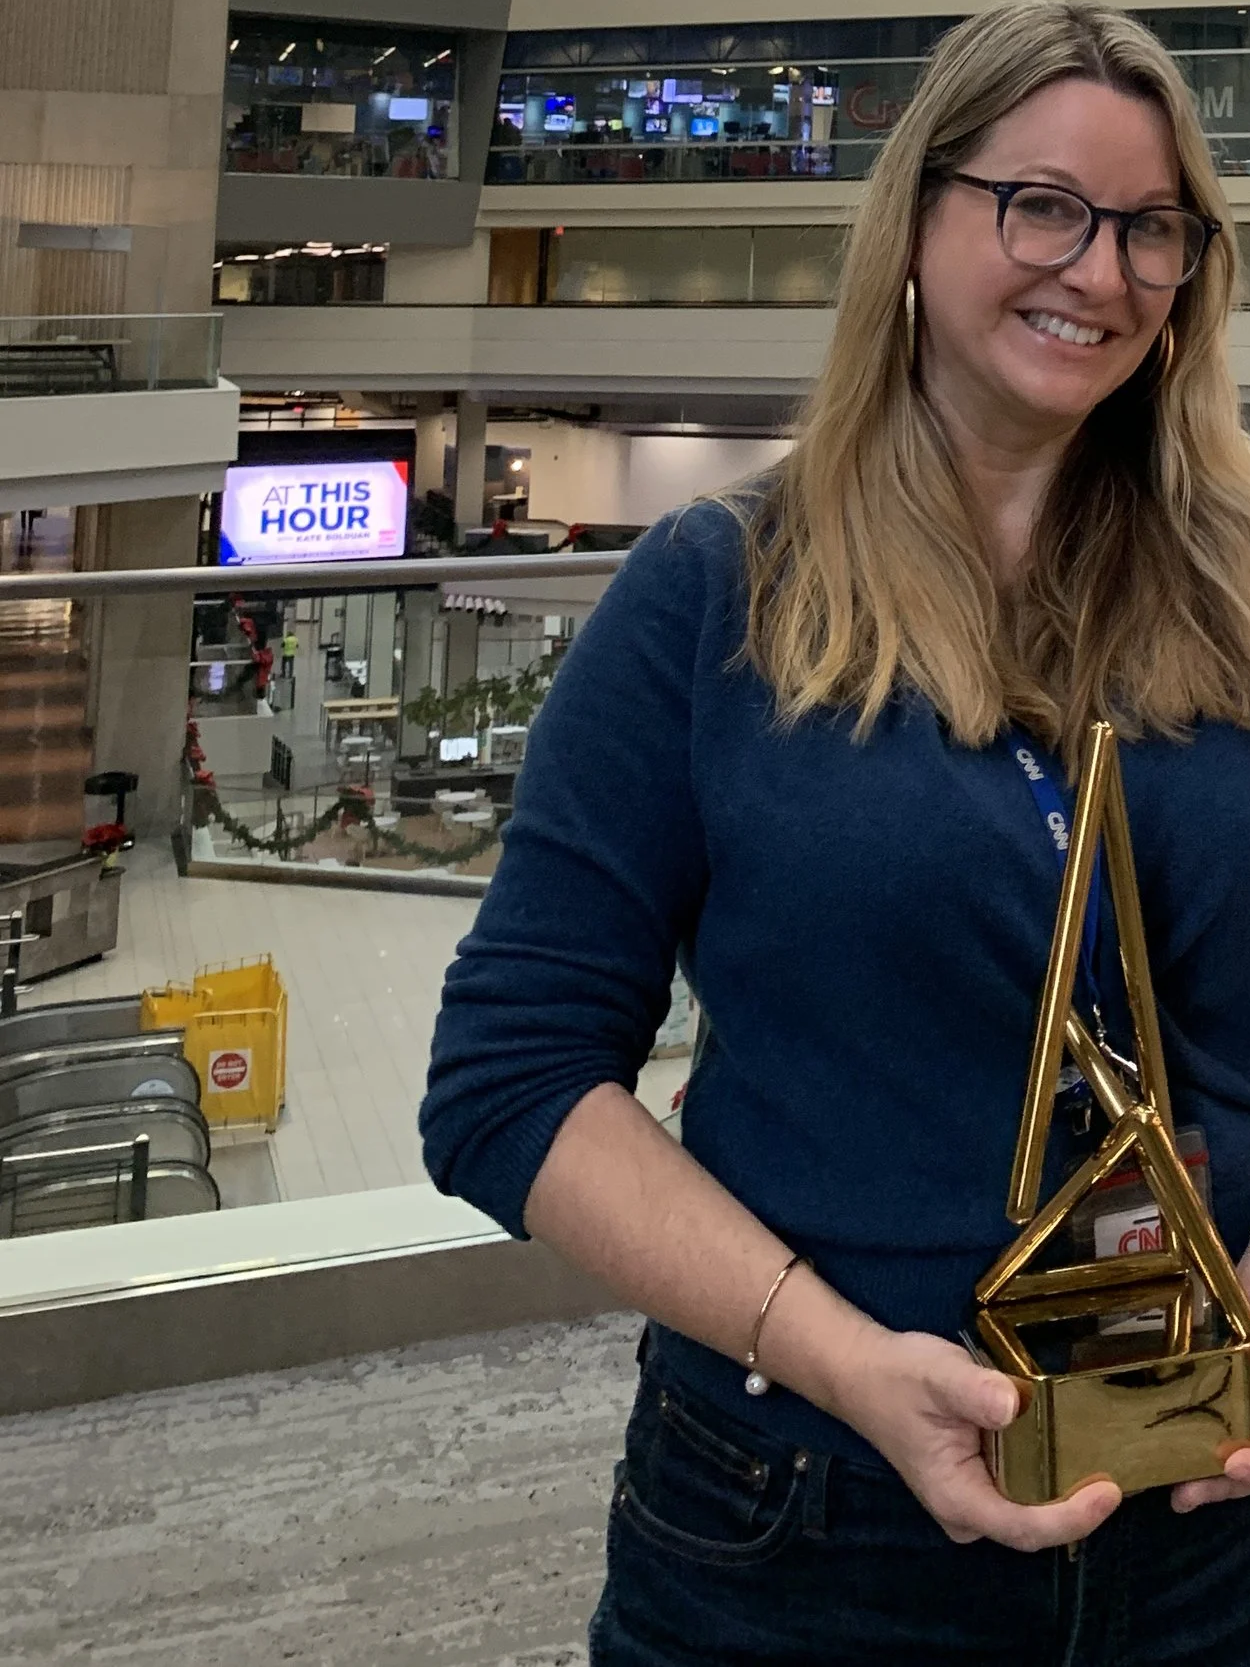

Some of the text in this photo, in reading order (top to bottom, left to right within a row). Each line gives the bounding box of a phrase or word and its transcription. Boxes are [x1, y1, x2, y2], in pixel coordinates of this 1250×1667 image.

[262, 481, 371, 506] AT THIS
[260, 505, 370, 535] HOUR
[1016, 748, 1044, 780] CNN
[1047, 811, 1069, 850] CNN
[1118, 1224, 1162, 1255] CN
